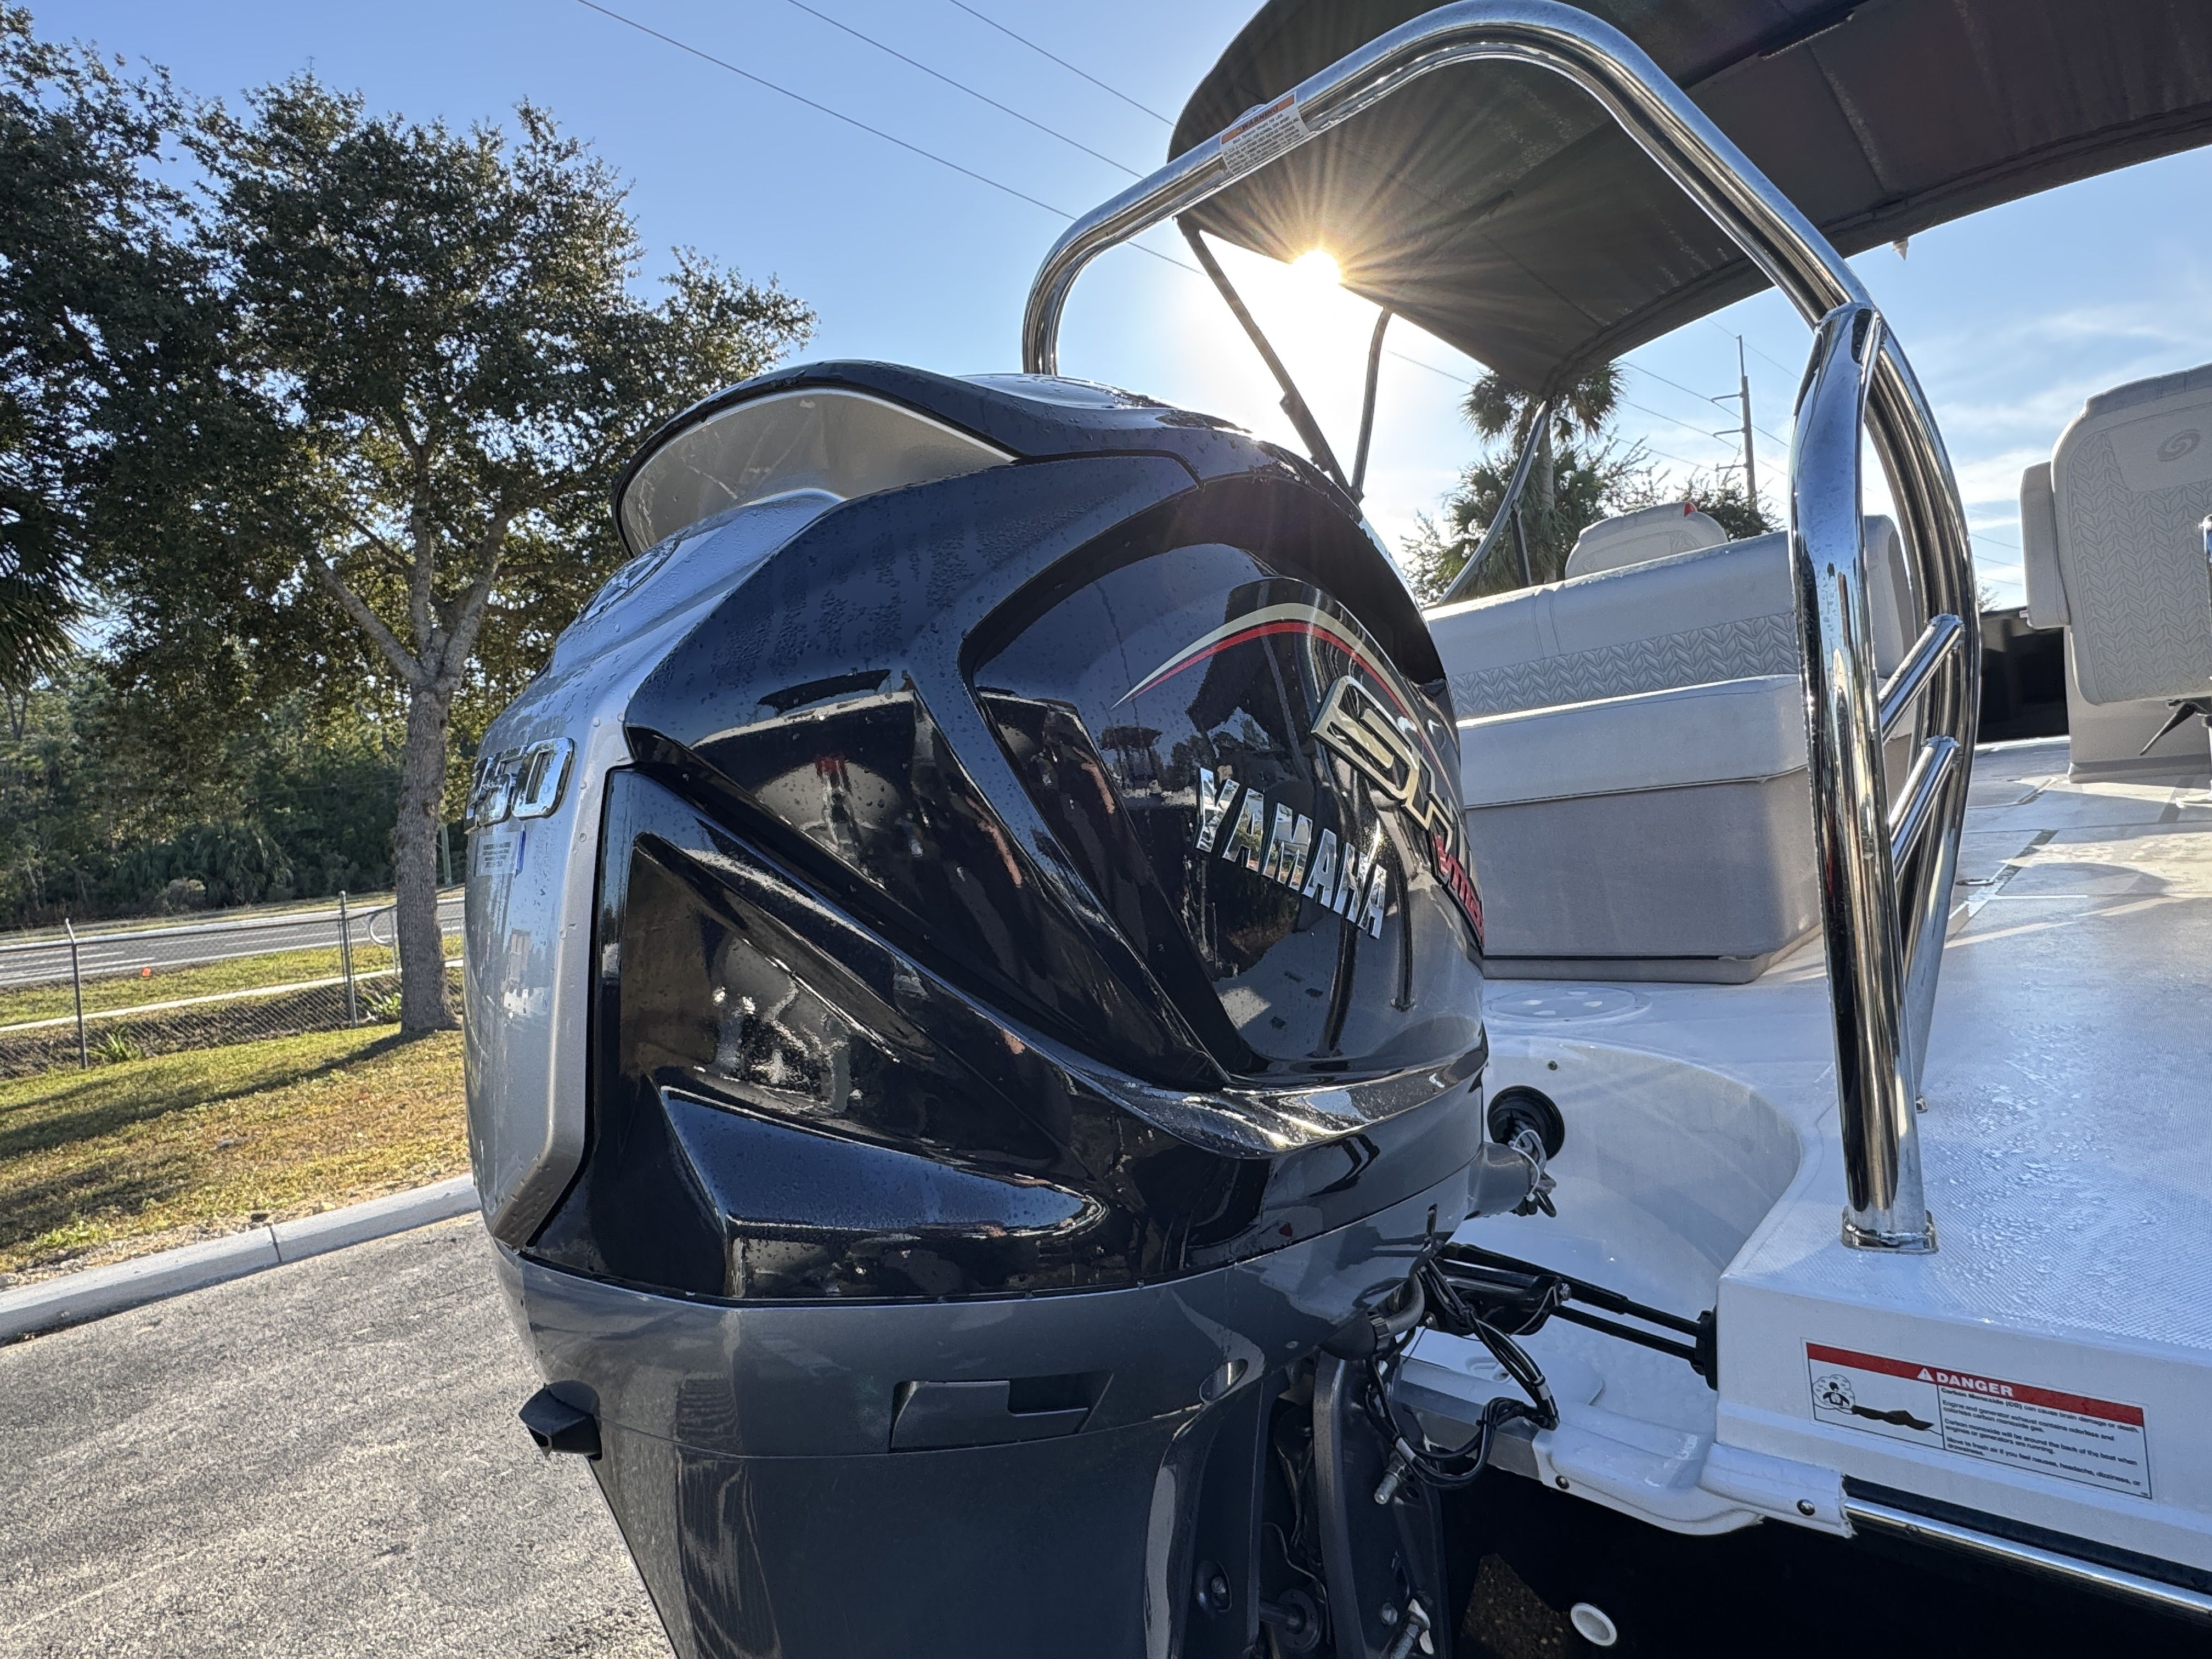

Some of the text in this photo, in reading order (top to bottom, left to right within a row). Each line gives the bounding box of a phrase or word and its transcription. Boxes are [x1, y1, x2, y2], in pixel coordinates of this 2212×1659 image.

[1195, 768, 1387, 939] YAMAHA
[1936, 1372, 2013, 1397] DANGER
[1941, 1388, 1967, 1397] Carbon
[1968, 1394, 2004, 1405] Monoxide
[2006, 1401, 2022, 1409] (CO)
[2079, 1417, 2106, 1426] damage
[1943, 1407, 1972, 1417] colorless
[1973, 1413, 1995, 1421] carbon
[1996, 1418, 2029, 1429] monoxide
[1943, 1400, 1965, 1409] Engine
[1979, 1408, 2010, 1418] generator
[2011, 1415, 2036, 1424] exhaust
[2039, 1421, 2067, 1431] contains
[2069, 1427, 2099, 1438] odorless
[1945, 1425, 1970, 1435] engines
[1979, 1433, 2014, 1444] generators
[1945, 1418, 1967, 1427] Carbon
[1968, 1425, 2000, 1435] monoxide
[2024, 1437, 2047, 1445] around
[2061, 1444, 2078, 1453] back
[2100, 1452, 2116, 1460] boat
[2117, 1457, 2137, 1465] when
[1972, 1442, 1989, 1451] fresh
